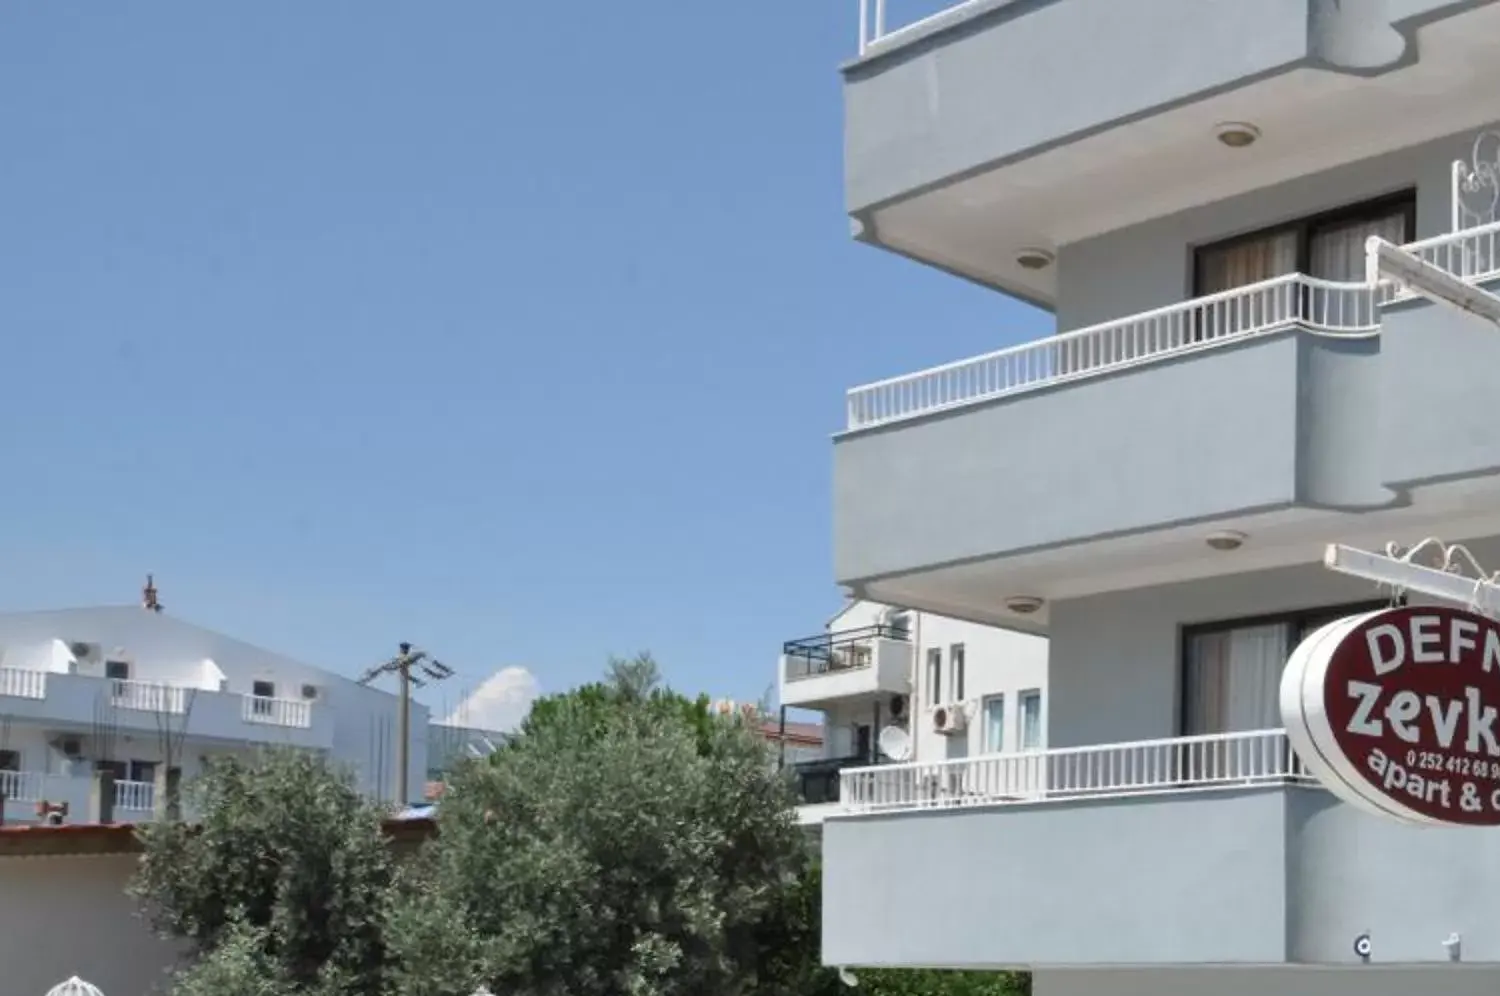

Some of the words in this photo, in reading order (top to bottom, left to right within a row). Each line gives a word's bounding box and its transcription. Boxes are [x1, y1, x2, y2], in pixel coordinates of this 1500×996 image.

[1367, 748, 1450, 808] apart
[1459, 782, 1482, 813] &
[1407, 749, 1417, 767] 0
[1419, 751, 1444, 771] 252
[1445, 756, 1470, 775] 412
